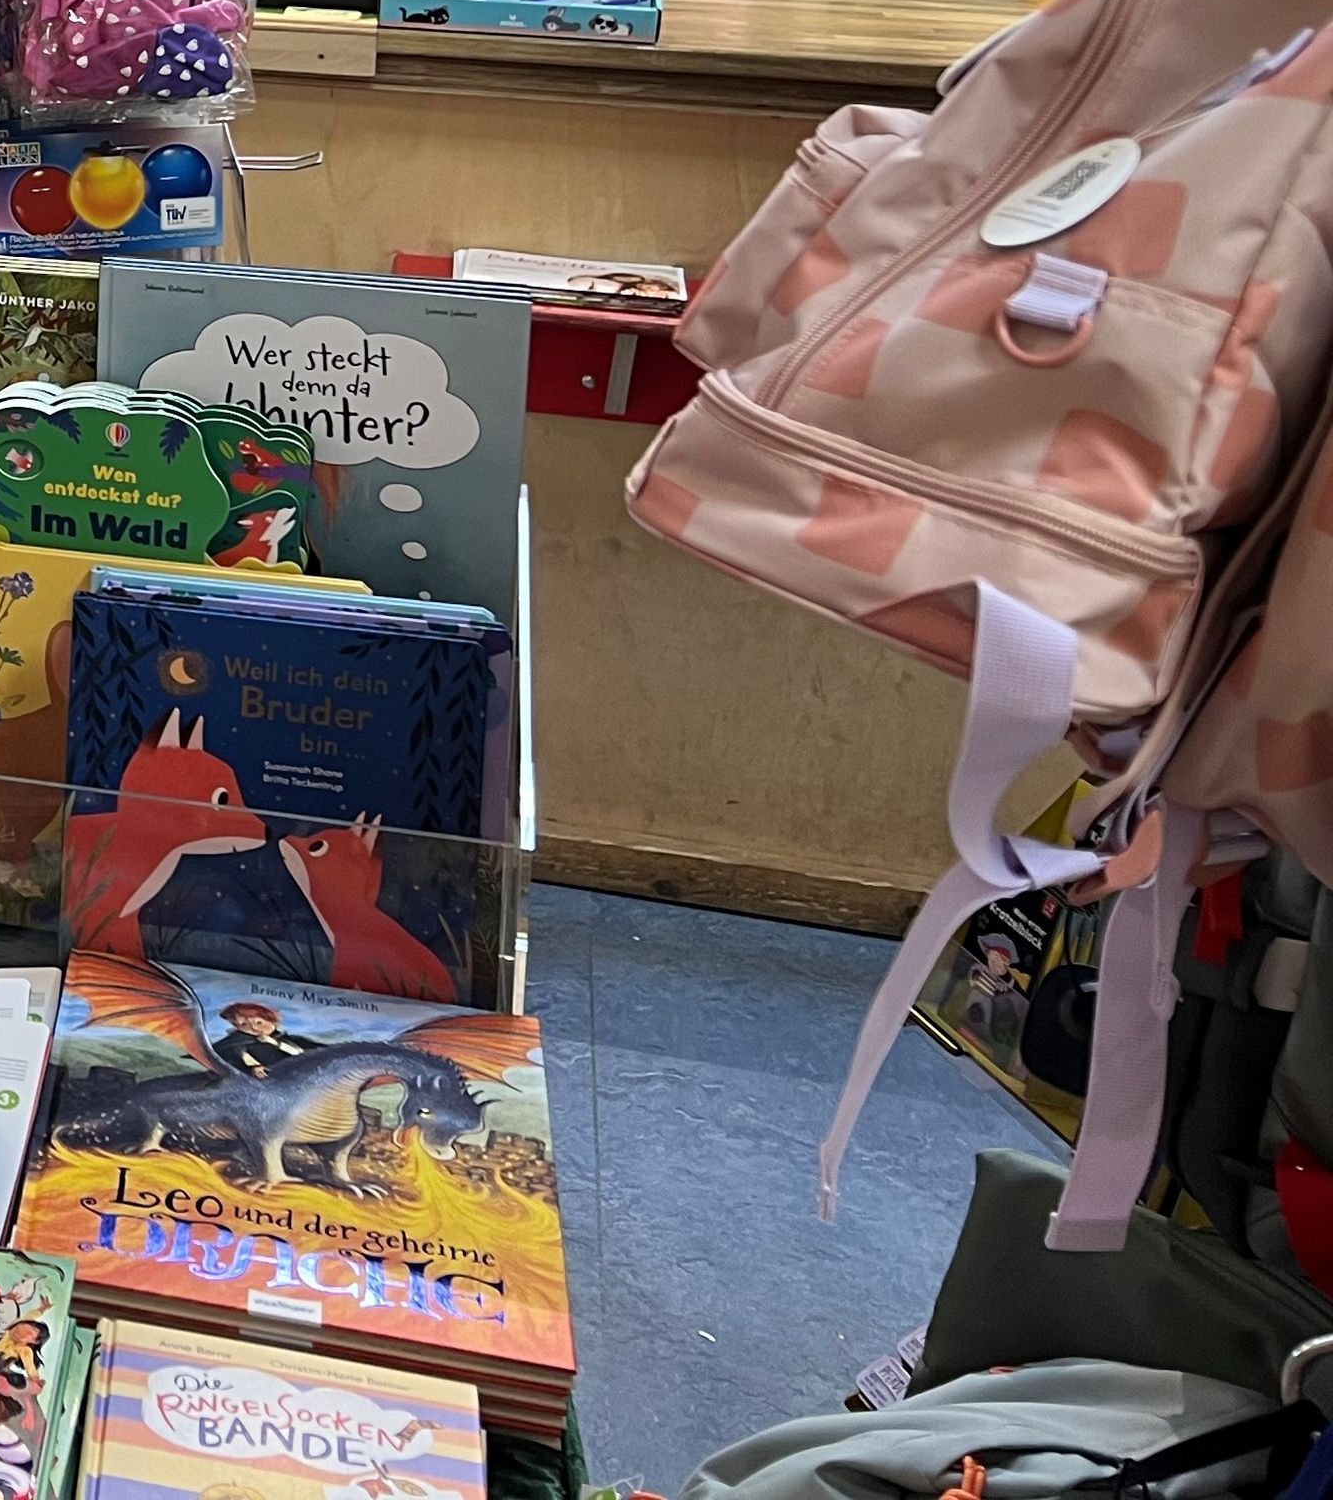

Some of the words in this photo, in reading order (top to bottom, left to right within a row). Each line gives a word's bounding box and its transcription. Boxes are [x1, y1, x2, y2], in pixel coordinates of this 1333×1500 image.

[225, 334, 293, 368] Wer
[305, 338, 393, 376] steckt
[281, 370, 337, 396] denn
[346, 373, 372, 398] da
[43, 479, 140, 505] entdeckst
[145, 490, 183, 511] du?
[93, 463, 137, 485] Wen
[30, 503, 78, 538] Im
[90, 510, 189, 550] Wald
[224, 654, 278, 683] Weil
[287, 665, 323, 687] ich
[334, 670, 389, 696] dein
[240, 684, 374, 731] Bruder
[299, 732, 338, 756] bin
[250, 982, 295, 1002] Briony
[301, 990, 332, 1008] May
[336, 995, 380, 1014] Smith
[114, 1166, 225, 1220] Leo
[233, 1203, 293, 1231] und
[304, 1213, 357, 1241] der
[365, 1228, 497, 1269] geheime
[77, 1197, 506, 1327] DRACHE
[173, 1372, 235, 1392] Die
[197, 1415, 370, 1468] BANDE
